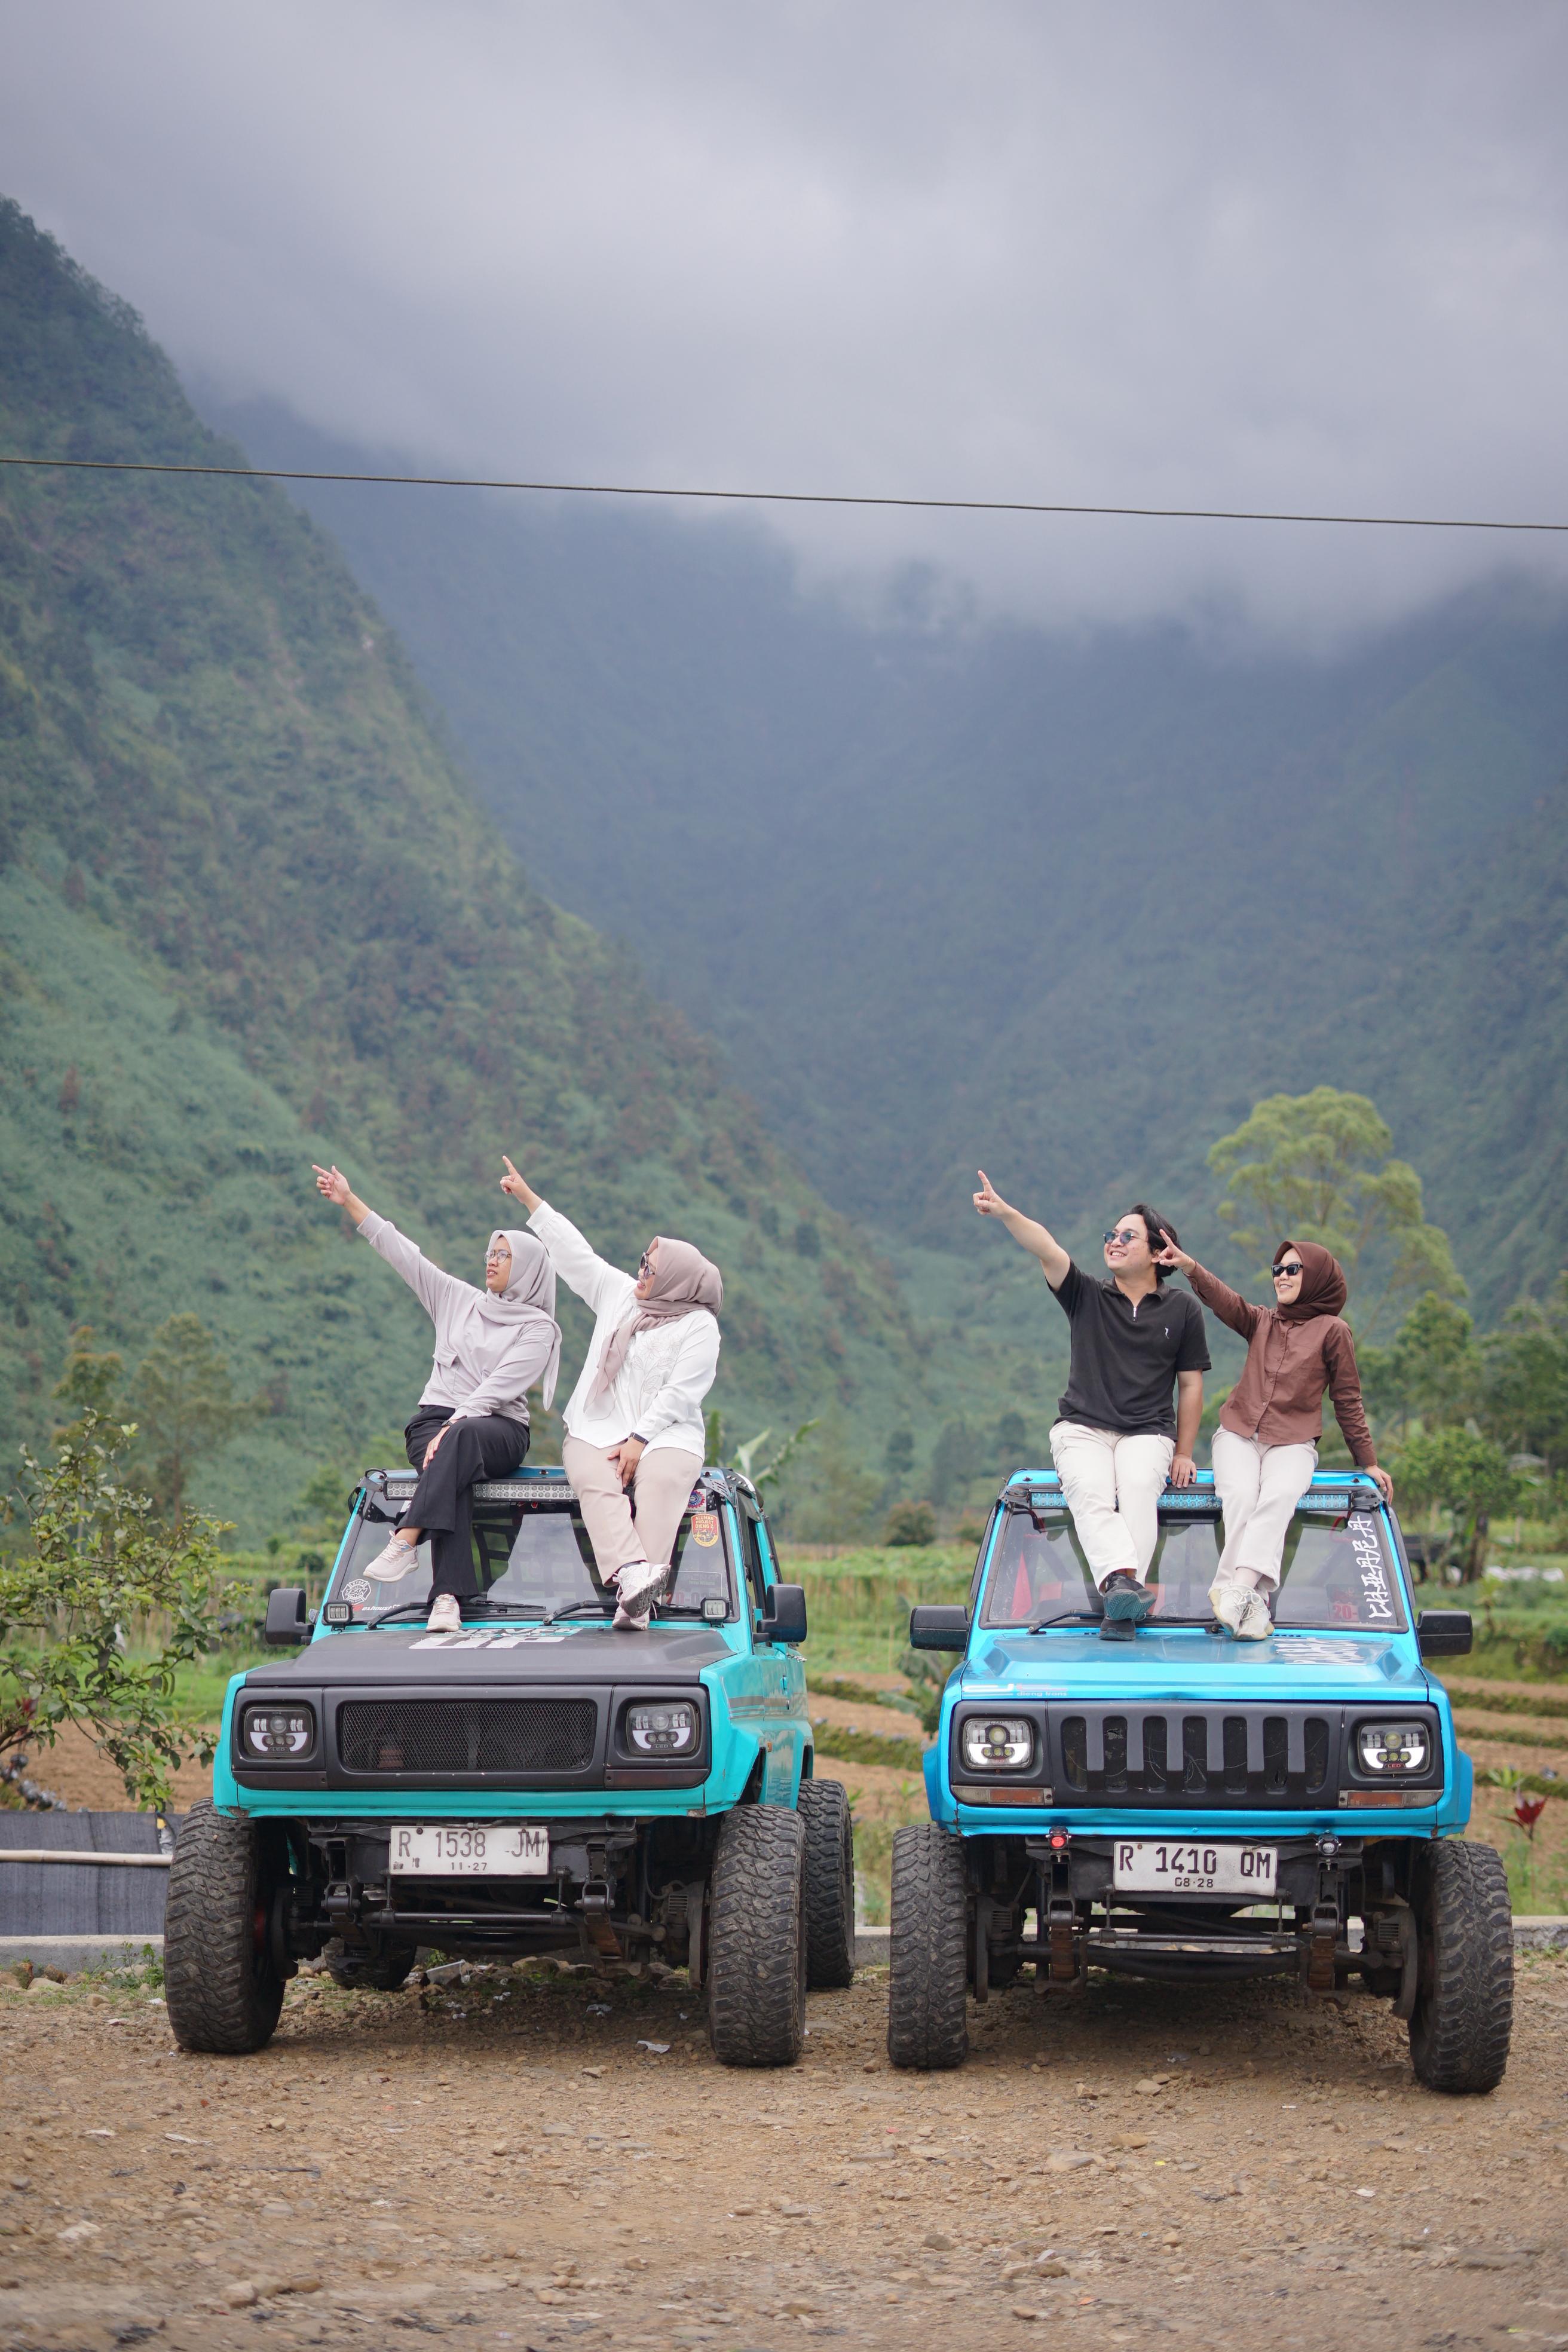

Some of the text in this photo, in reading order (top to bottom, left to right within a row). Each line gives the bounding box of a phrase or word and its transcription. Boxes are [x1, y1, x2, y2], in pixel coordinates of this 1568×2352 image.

[409, 1636, 565, 1649] UP
[399, 1830, 540, 1857] R 1538 JM
[1119, 1845, 1270, 1879] R 1410 QM
